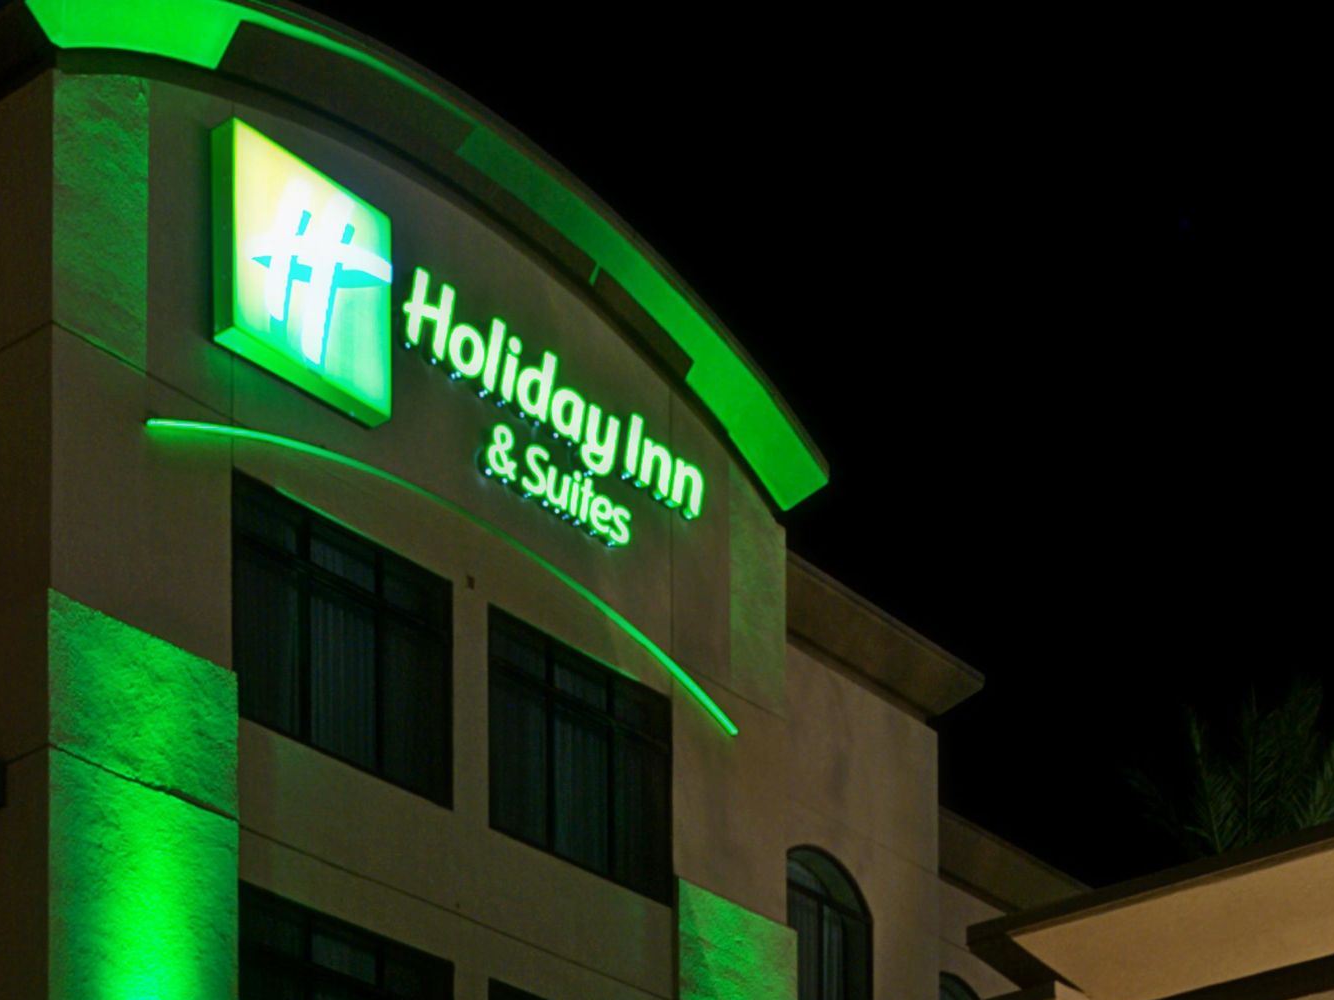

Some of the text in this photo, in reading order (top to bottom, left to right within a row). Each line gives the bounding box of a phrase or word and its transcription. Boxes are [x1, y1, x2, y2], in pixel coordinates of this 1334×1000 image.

[403, 267, 703, 519] Holiday Inn
[485, 424, 631, 547] & Suites
